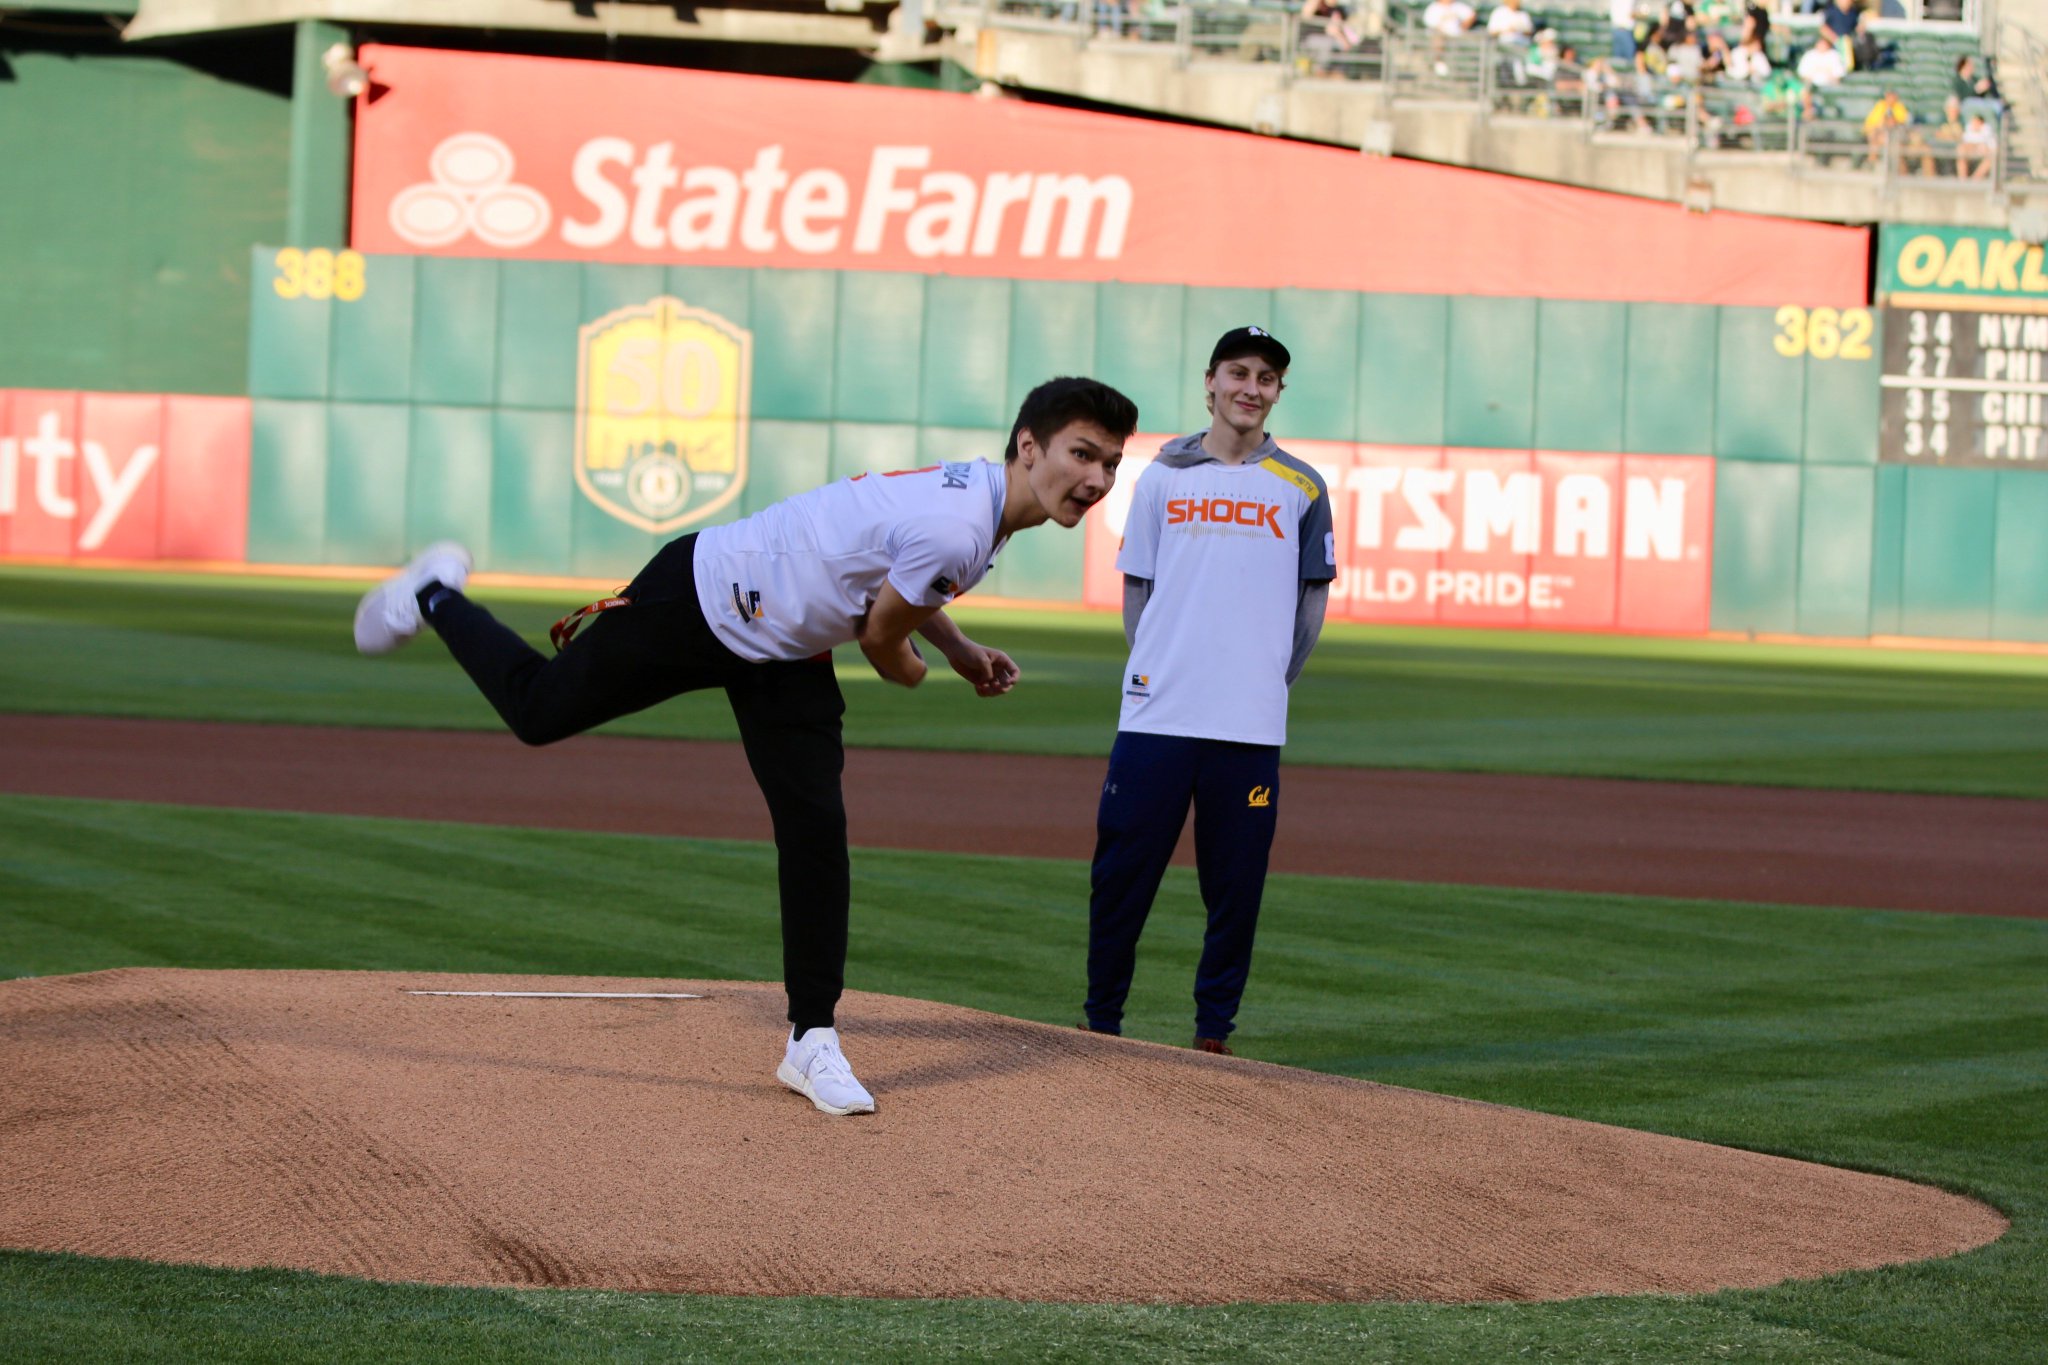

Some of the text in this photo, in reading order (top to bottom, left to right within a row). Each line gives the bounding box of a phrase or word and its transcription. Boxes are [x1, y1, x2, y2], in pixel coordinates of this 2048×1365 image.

[273, 247, 367, 302] 388
[1773, 304, 1873, 360] 362
[1978, 313, 2048, 350] NYM
[1984, 349, 2042, 382] PHI
[1981, 391, 2042, 425] CHI
[1984, 425, 2042, 460] PIT
[1167, 499, 1285, 539] SHOCK
[1329, 566, 1418, 604] UILD
[1247, 786, 1271, 807] Cal
